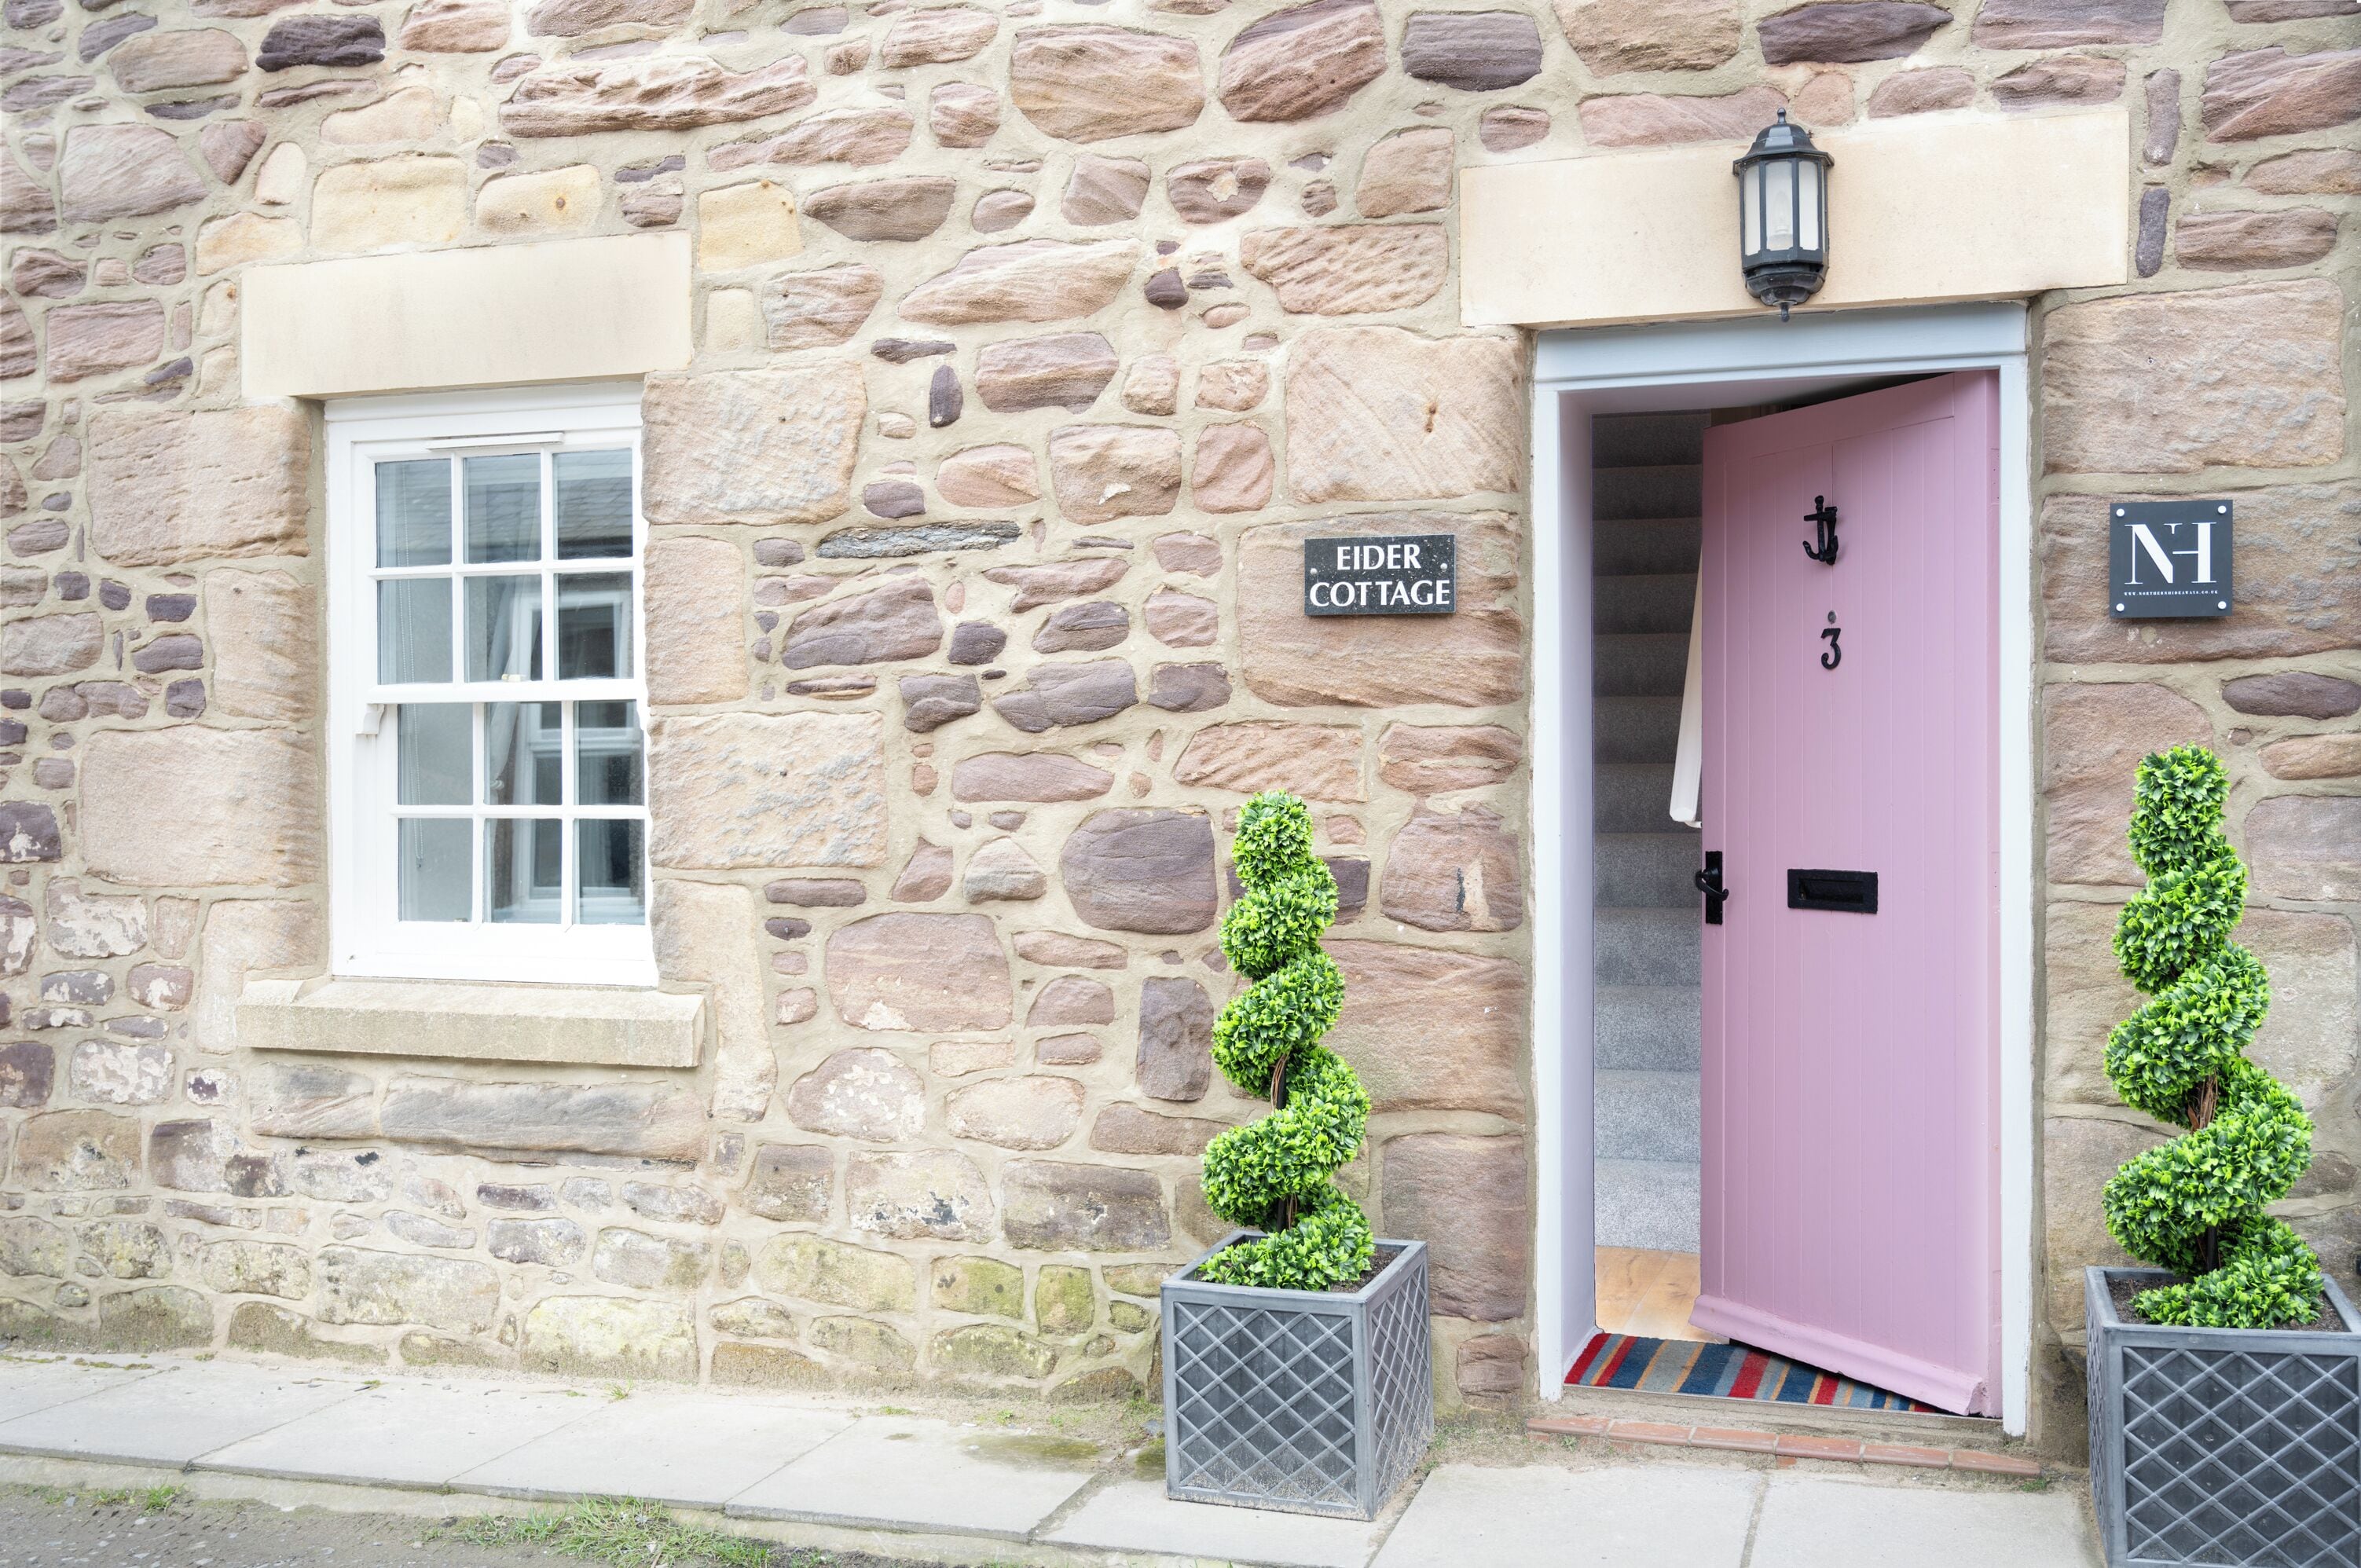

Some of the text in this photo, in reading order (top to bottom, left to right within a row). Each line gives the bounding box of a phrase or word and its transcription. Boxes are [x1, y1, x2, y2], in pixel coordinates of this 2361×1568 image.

[1337, 544, 1421, 570] EIDER
[2125, 522, 2217, 584] NH
[1310, 580, 1450, 607] COTTAGE
[1820, 628, 1842, 670] 3
